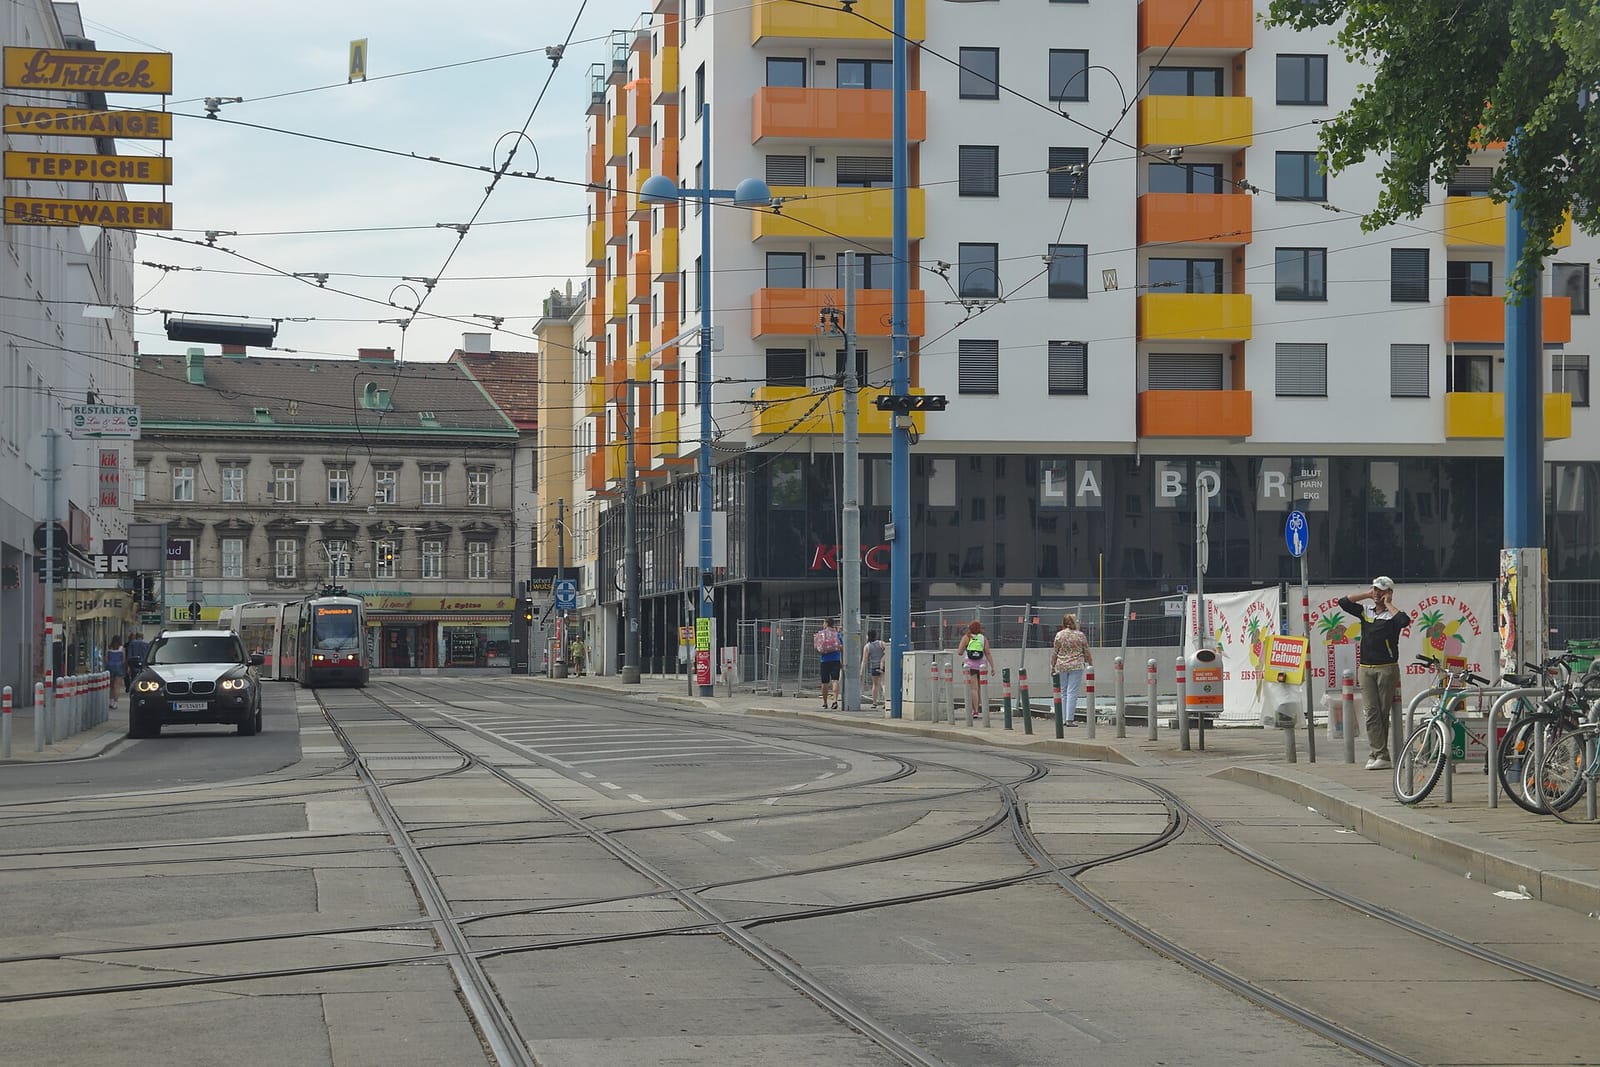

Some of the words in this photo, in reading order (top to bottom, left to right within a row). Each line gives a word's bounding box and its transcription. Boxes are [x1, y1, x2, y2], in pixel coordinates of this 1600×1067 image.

[16, 110, 160, 134] VORHÄNGE
[27, 157, 150, 179] TEPPICHE
[14, 202, 164, 225] BETTWAREN
[74, 406, 138, 415] RESTAURANT
[101, 453, 117, 467] kik
[1301, 469, 1322, 477] BLUT
[101, 491, 117, 505] kik
[1303, 492, 1320, 500] EKG
[808, 543, 891, 571] KC
[1246, 603, 1257, 616] EIS
[1318, 597, 1339, 613] EIS
[1418, 595, 1438, 612] EIS
[1441, 595, 1457, 607] IN
[1458, 601, 1482, 637] WIEN
[1273, 640, 1303, 654] Kronen
[1271, 651, 1301, 666] Zeitung
[1241, 671, 1251, 680] EIS
[1406, 665, 1426, 675] EIS
